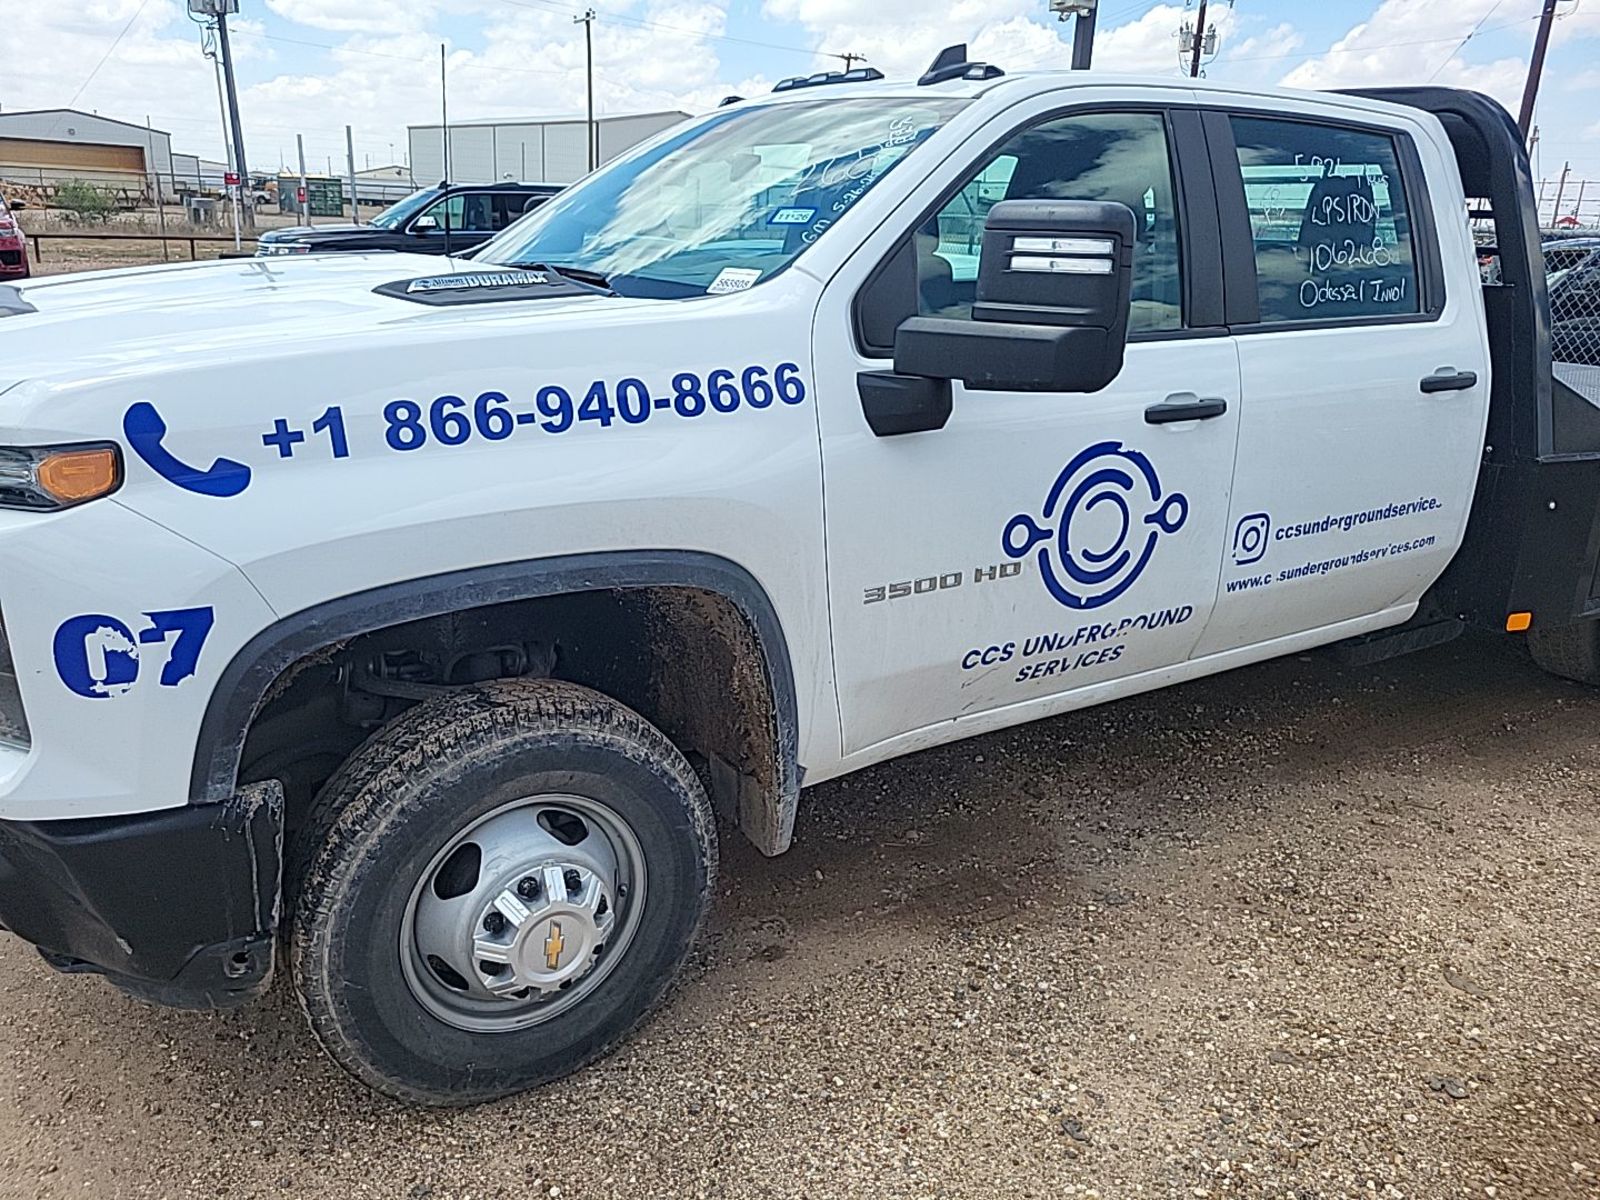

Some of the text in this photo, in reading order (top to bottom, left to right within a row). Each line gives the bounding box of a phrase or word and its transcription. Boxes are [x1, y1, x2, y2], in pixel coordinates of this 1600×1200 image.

[1309, 236, 1392, 274] 106268
[466, 272, 549, 289] DURAMAX
[262, 361, 806, 460] +1 866-940-8666
[863, 561, 1022, 605] 3500 HD
[52, 604, 216, 699] 07
[961, 643, 1016, 671] CCS
[1014, 644, 1126, 683] SERVICES
